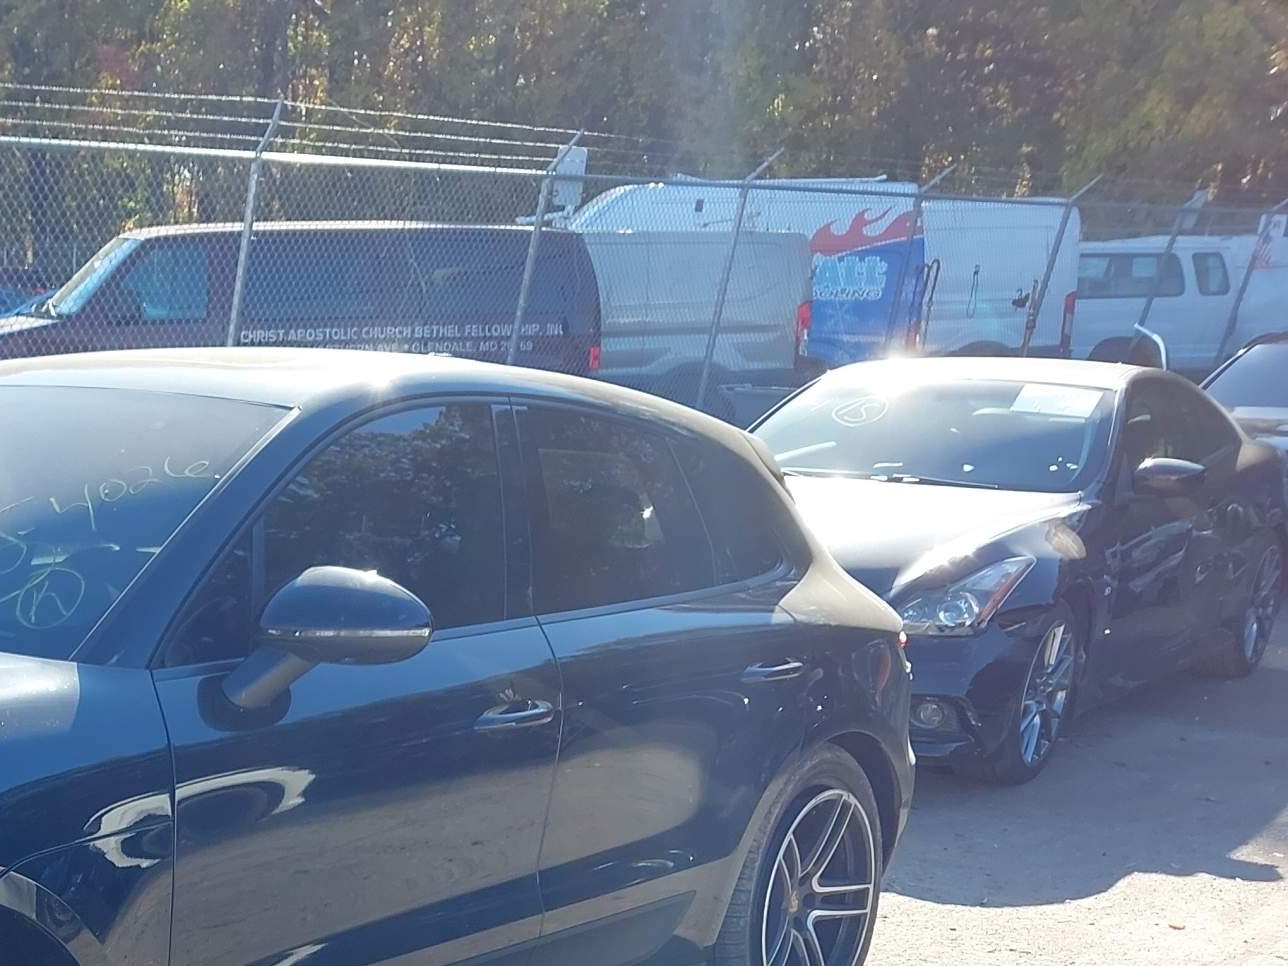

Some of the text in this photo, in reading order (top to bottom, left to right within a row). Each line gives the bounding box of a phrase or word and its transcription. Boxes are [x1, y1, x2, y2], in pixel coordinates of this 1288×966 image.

[240, 329, 285, 343] CHRIST
[288, 326, 359, 342] APOSTOLIC
[362, 325, 411, 339] CHURCH
[414, 323, 460, 338] BETHEL
